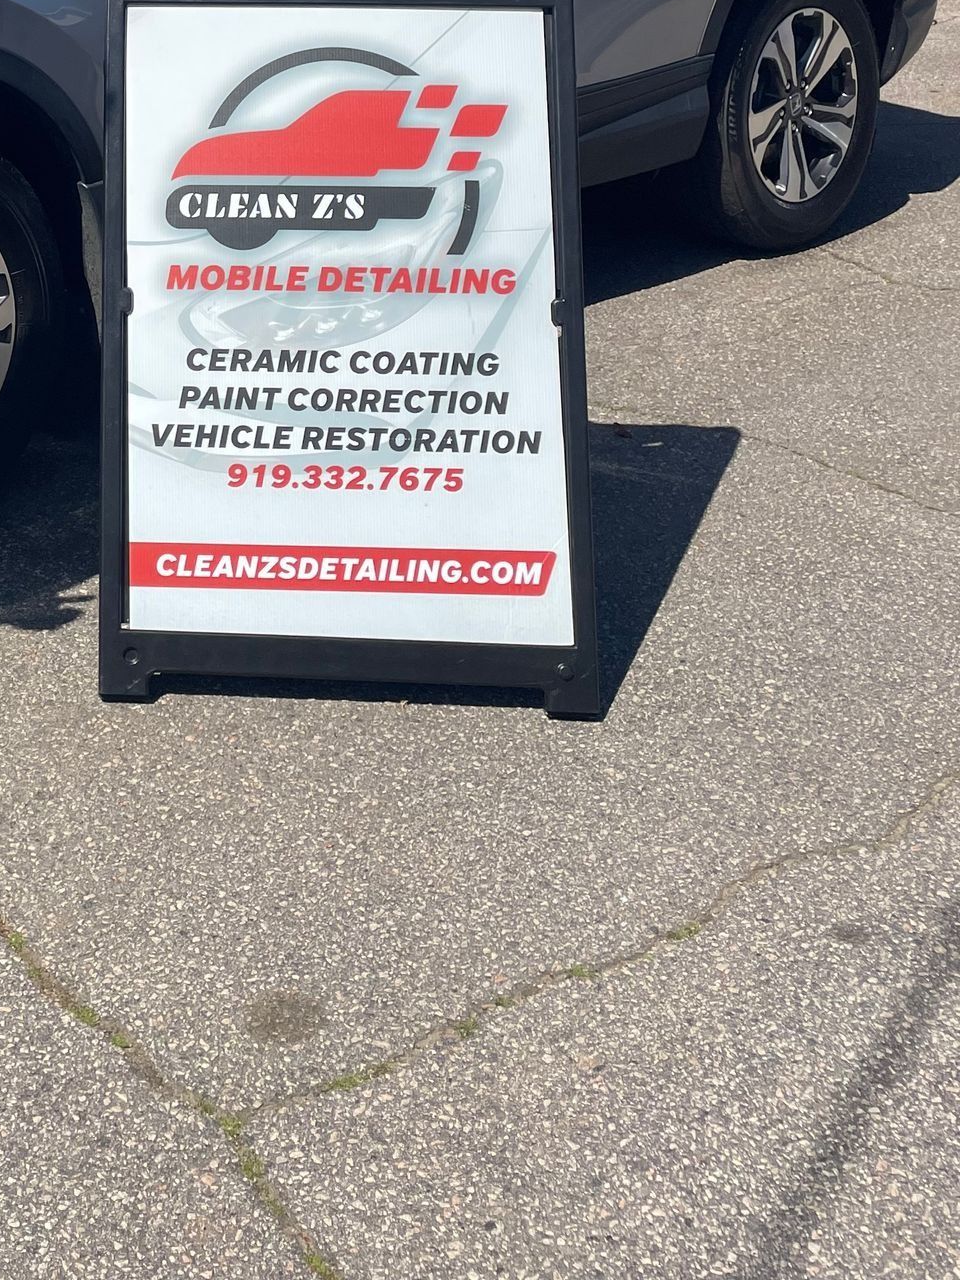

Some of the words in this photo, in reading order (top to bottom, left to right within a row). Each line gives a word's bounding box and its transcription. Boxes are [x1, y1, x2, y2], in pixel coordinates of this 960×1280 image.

[178, 192, 299, 219] CLEAN
[311, 193, 366, 220] Z'S
[167, 264, 309, 292] MOBILE
[317, 266, 517, 295] DETAILING
[186, 347, 342, 374] CERAMIC
[349, 350, 500, 377] COATING
[178, 386, 282, 411] PAINT
[287, 387, 509, 415] CORRECTION
[151, 423, 294, 450] VEHICLE
[301, 426, 542, 454] RESTORATION
[227, 463, 464, 492] 919.332.7675
[156, 553, 543, 585] CLEANZSDETAILING.COM
